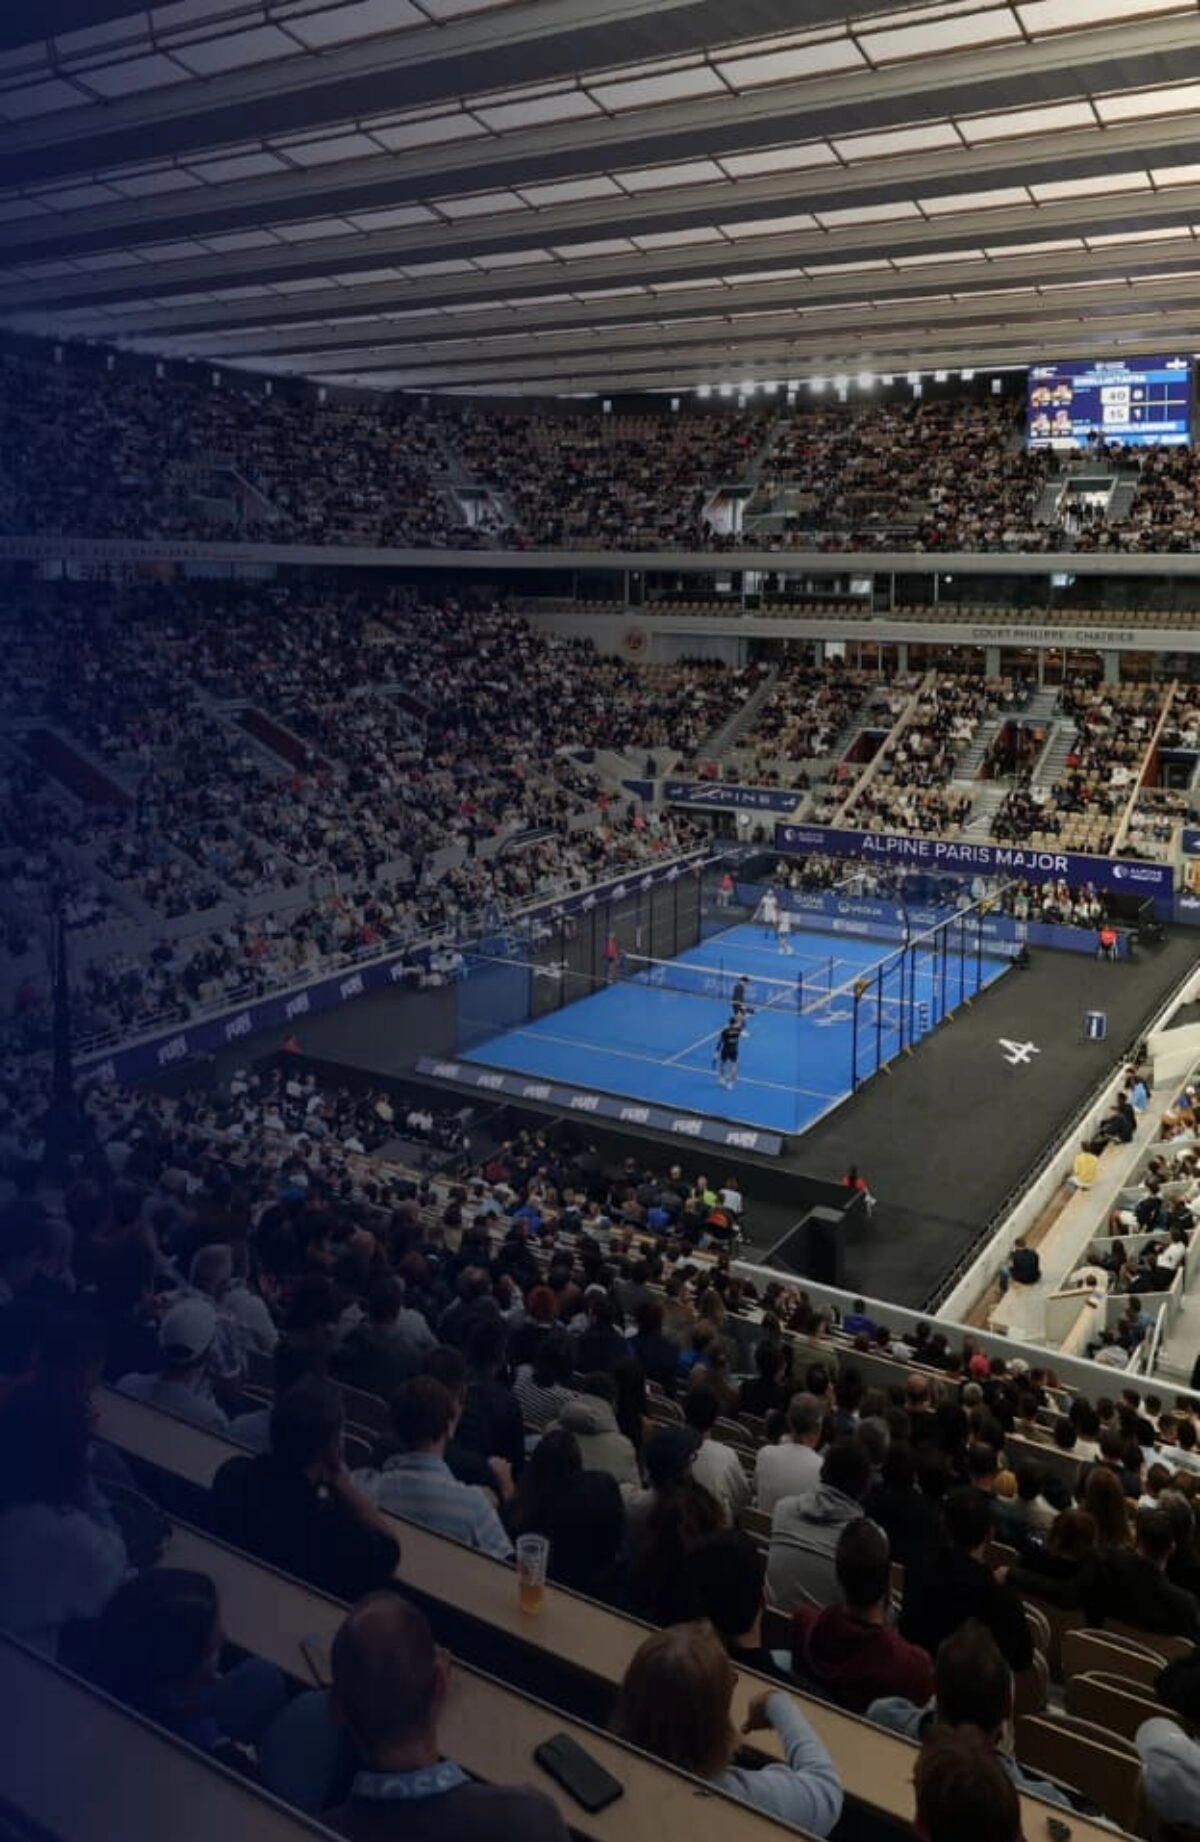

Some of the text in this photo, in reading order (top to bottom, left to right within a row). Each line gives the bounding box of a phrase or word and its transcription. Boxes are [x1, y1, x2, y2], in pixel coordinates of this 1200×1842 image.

[972, 629, 1011, 639] COURT
[1013, 630, 1064, 641] PHILIPPE
[862, 835, 1069, 873] ALPINE PARIS MAJOR
